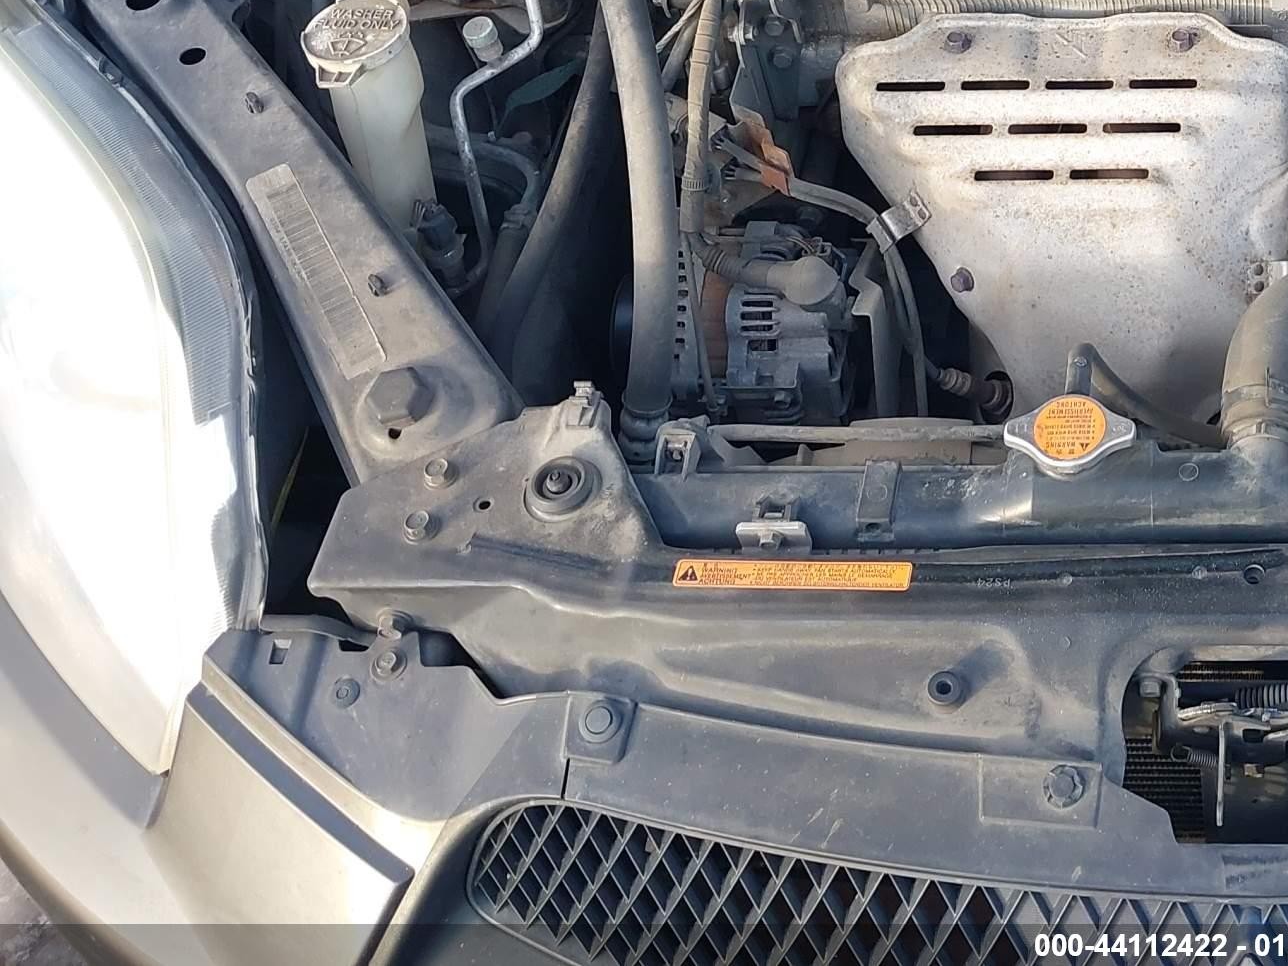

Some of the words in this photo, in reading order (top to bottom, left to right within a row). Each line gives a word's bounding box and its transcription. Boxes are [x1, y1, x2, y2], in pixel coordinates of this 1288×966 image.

[331, 9, 394, 19] WASHER
[314, 18, 357, 30] FLUID
[360, 19, 400, 30] ONLY
